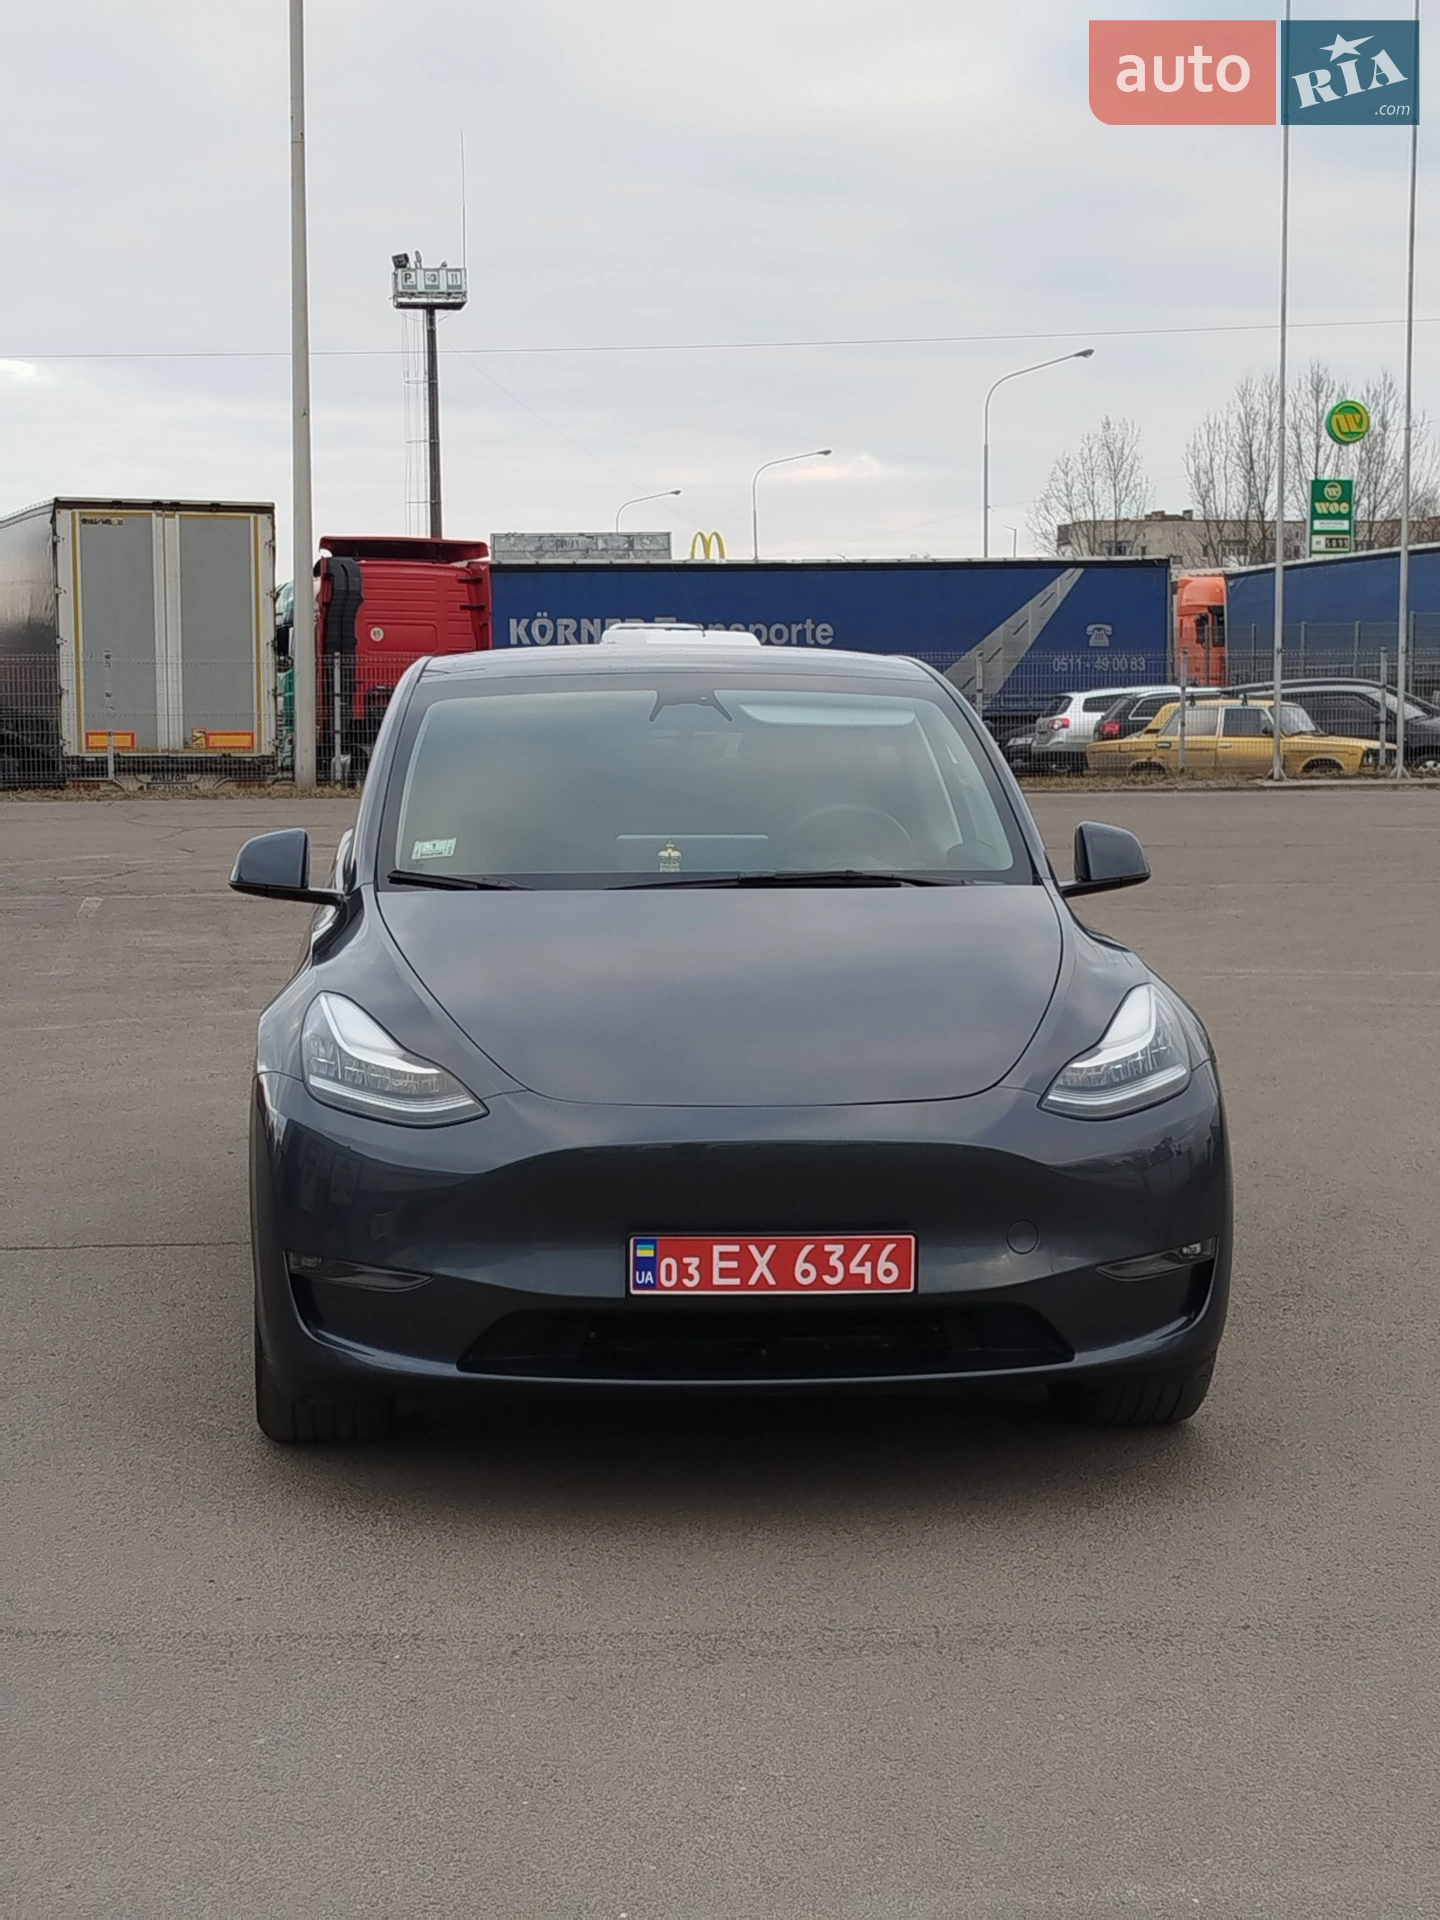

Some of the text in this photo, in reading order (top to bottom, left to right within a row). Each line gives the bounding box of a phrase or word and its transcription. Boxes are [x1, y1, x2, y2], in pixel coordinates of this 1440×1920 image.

[509, 612, 645, 645] KÖRN
[635, 1243, 899, 1287] UA 03 EX 6346
